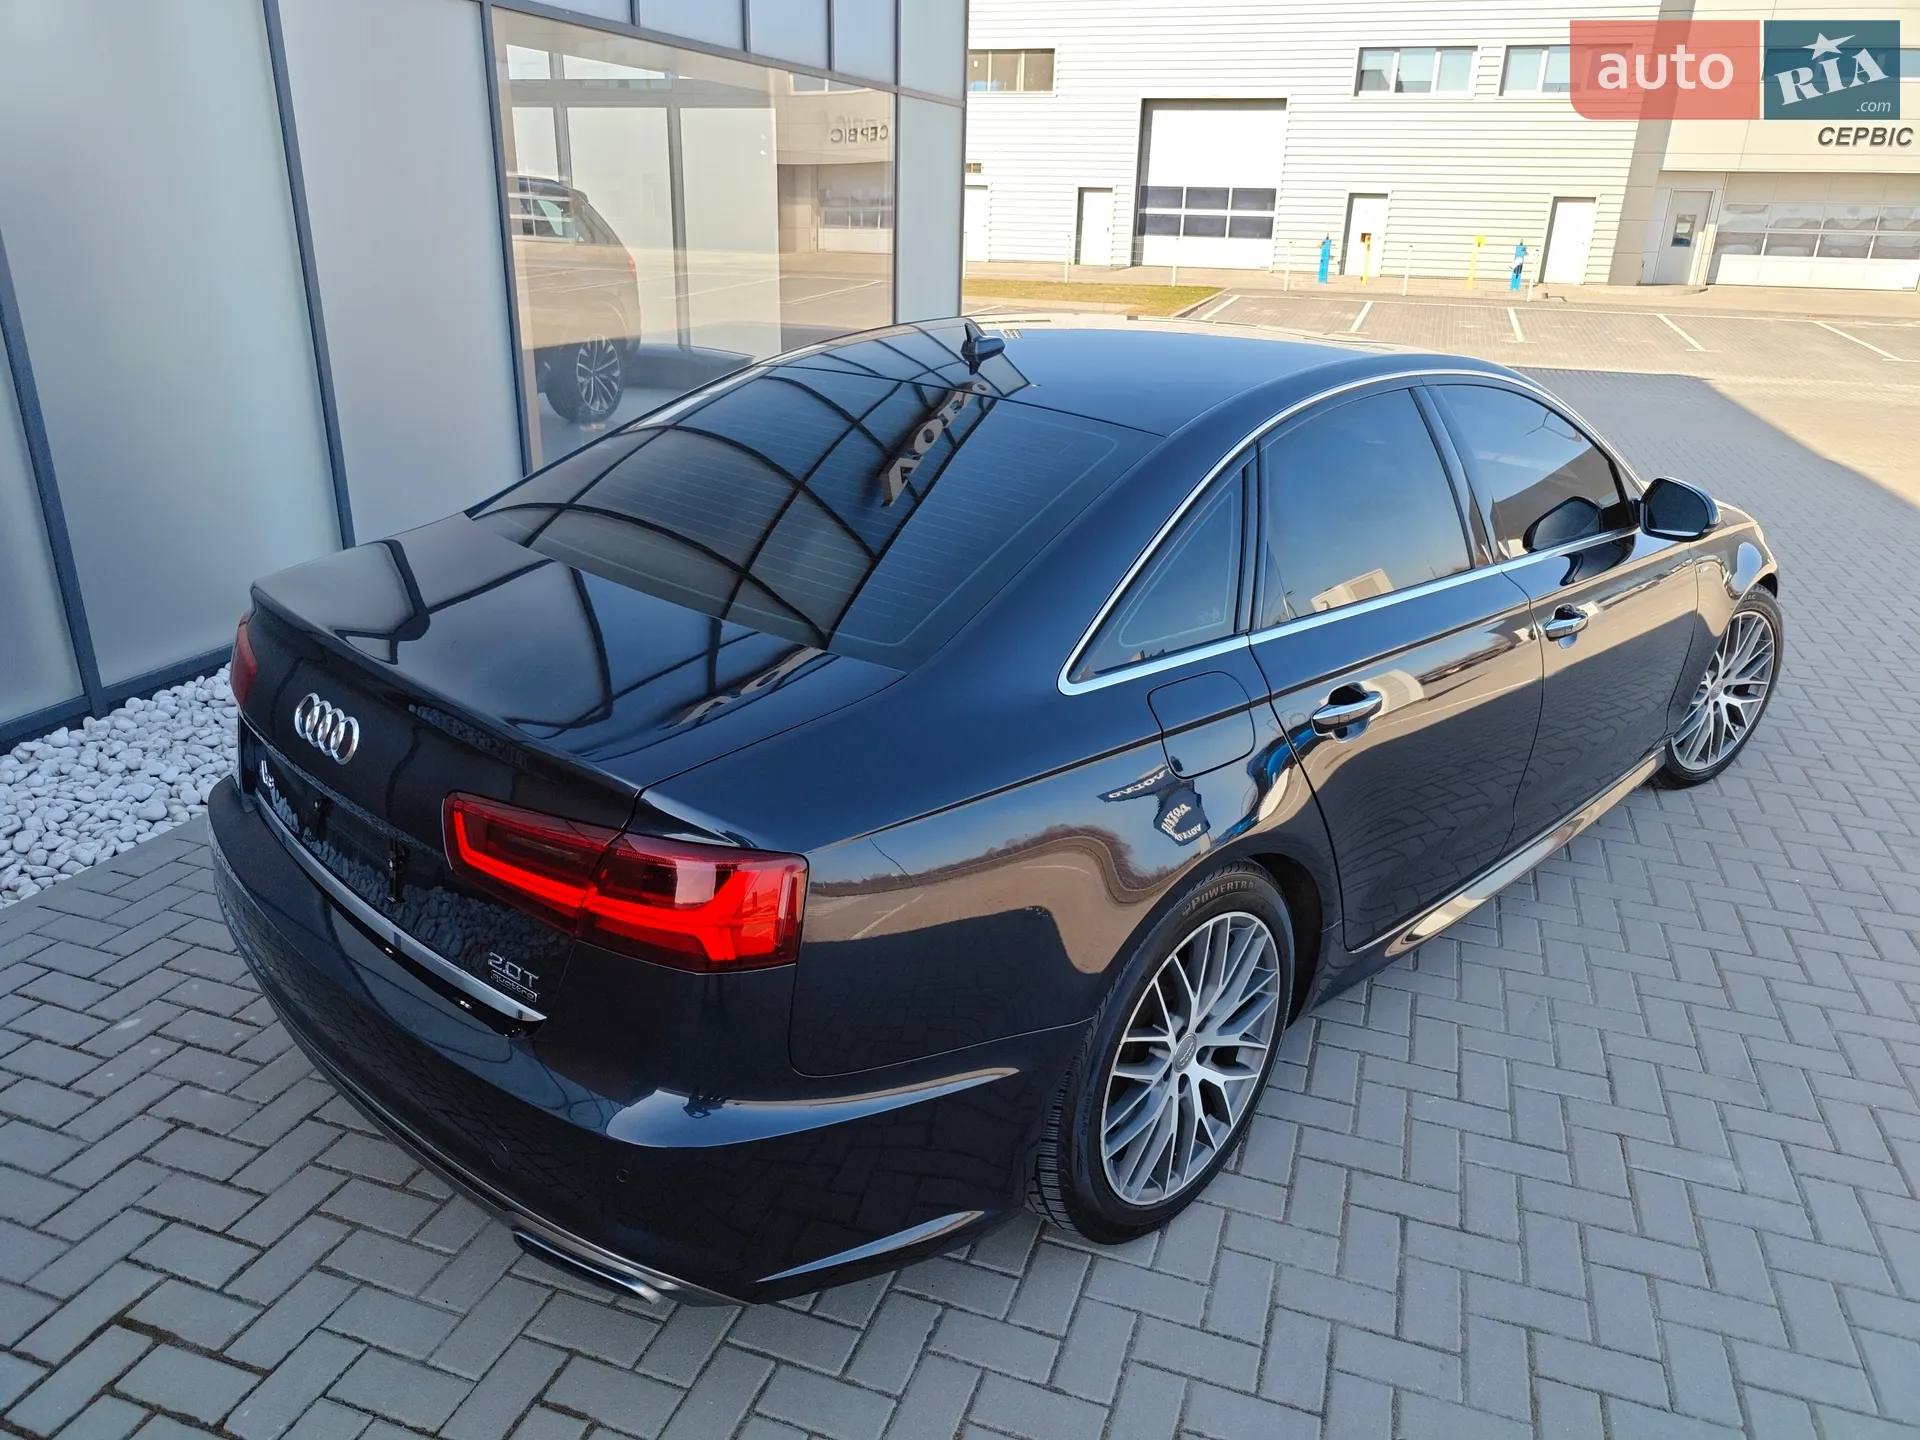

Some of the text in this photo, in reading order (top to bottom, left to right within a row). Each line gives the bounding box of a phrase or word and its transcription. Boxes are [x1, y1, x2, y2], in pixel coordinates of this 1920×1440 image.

[1817, 126, 1914, 147] СЕРВІС
[488, 951, 540, 988] 2.0T
[491, 972, 535, 1000] quattro
